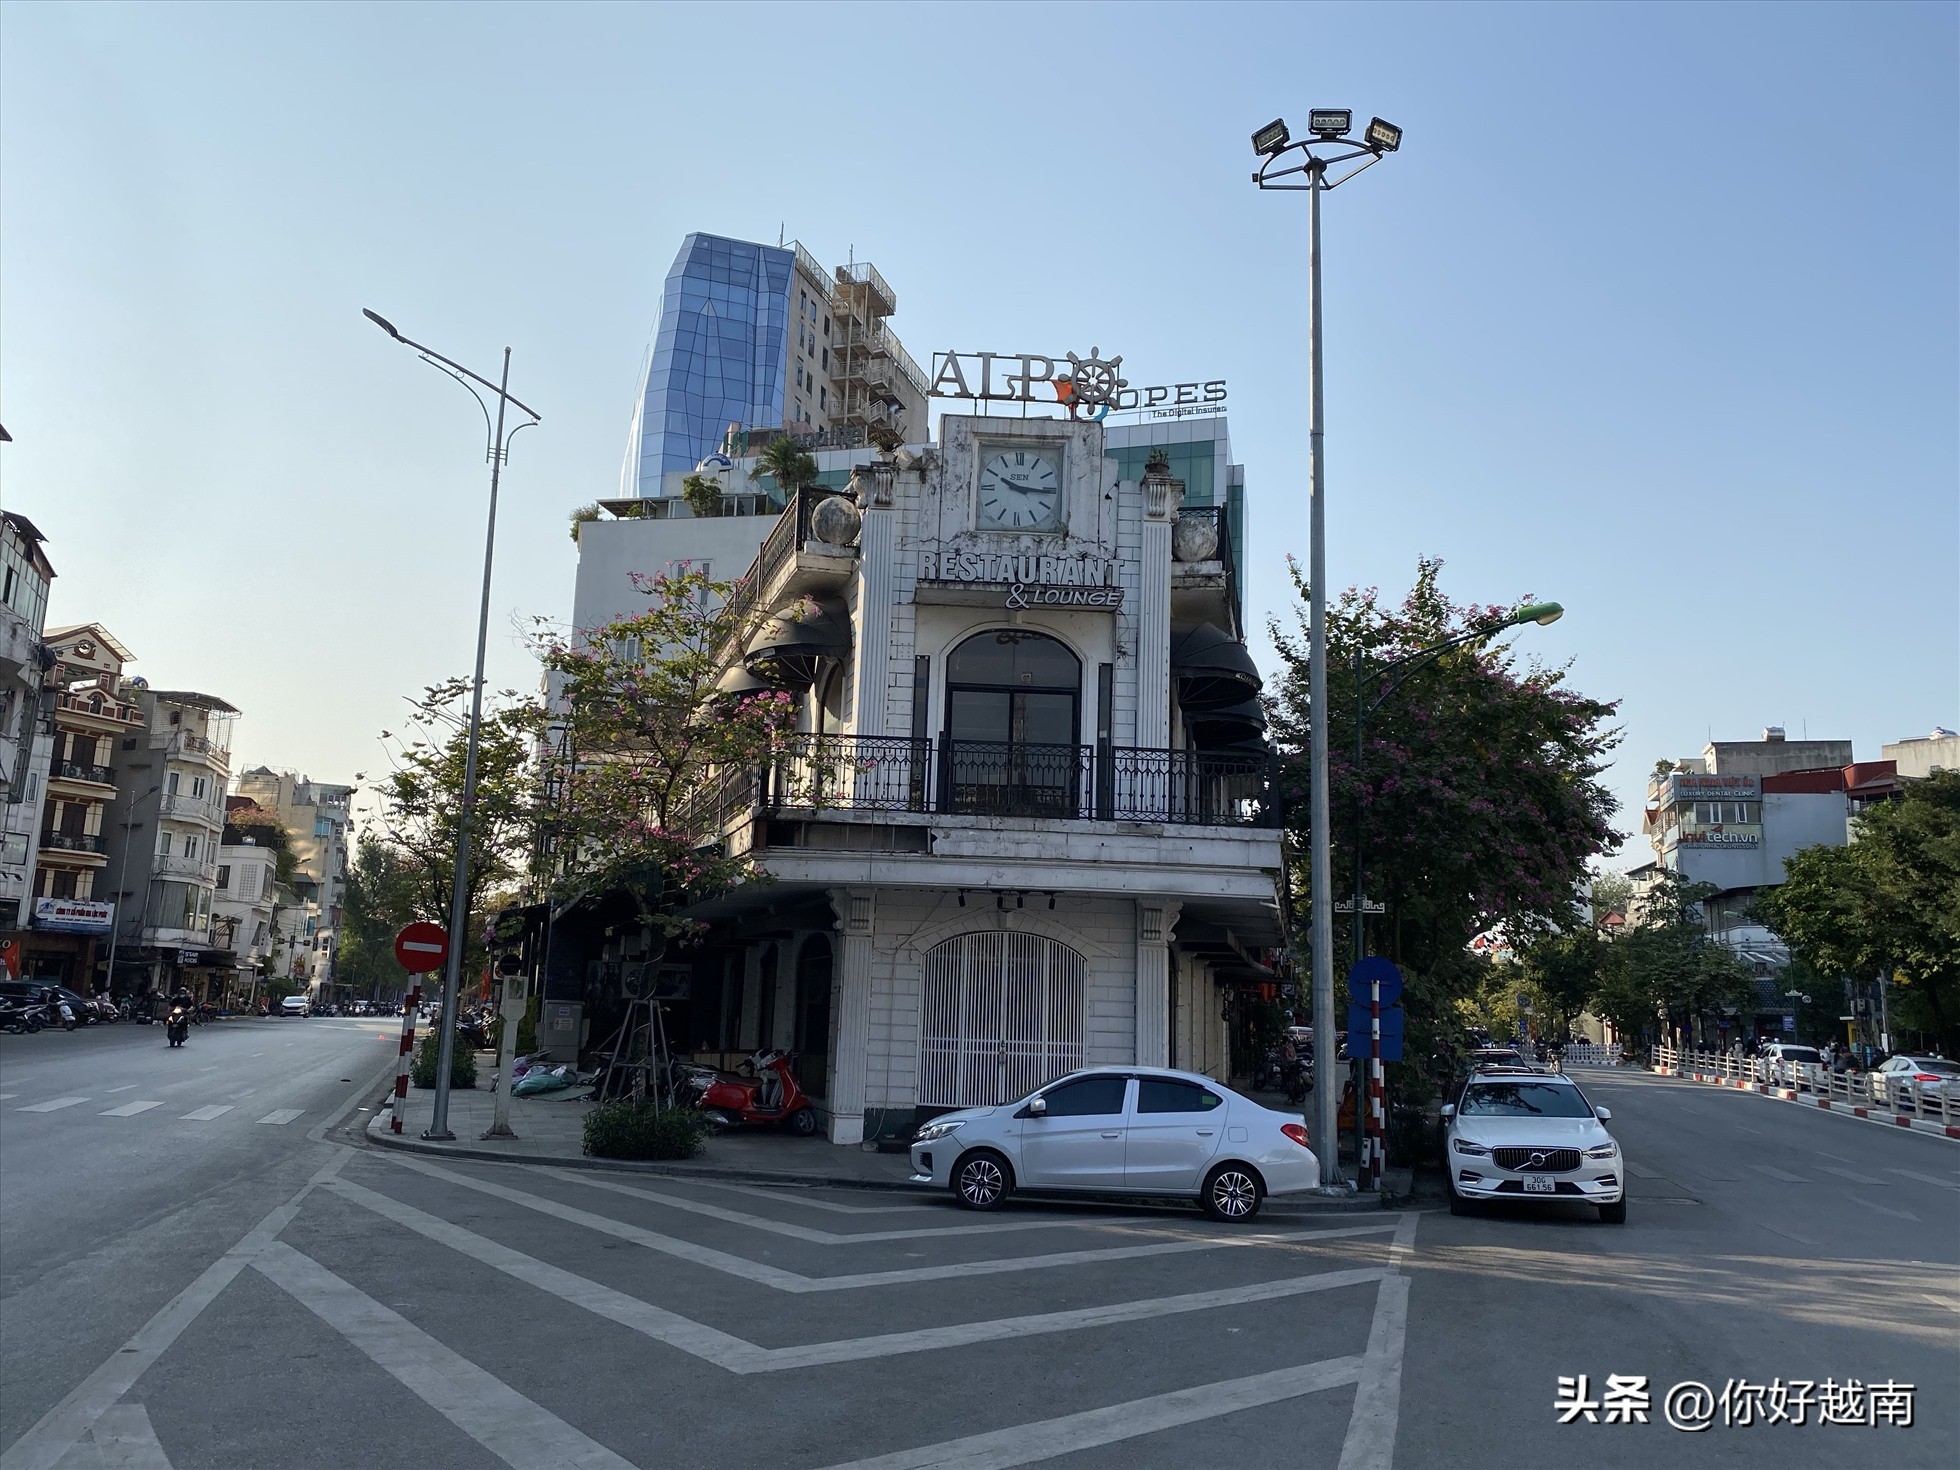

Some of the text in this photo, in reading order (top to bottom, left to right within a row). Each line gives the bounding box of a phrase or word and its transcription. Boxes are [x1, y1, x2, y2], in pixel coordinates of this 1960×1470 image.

[1117, 379, 1228, 410] OPES
[1152, 410, 1167, 418] The
[1169, 407, 1195, 417] Digital
[918, 551, 1125, 588] RESTAURANT
[1005, 584, 1121, 609] & LOUNGE
